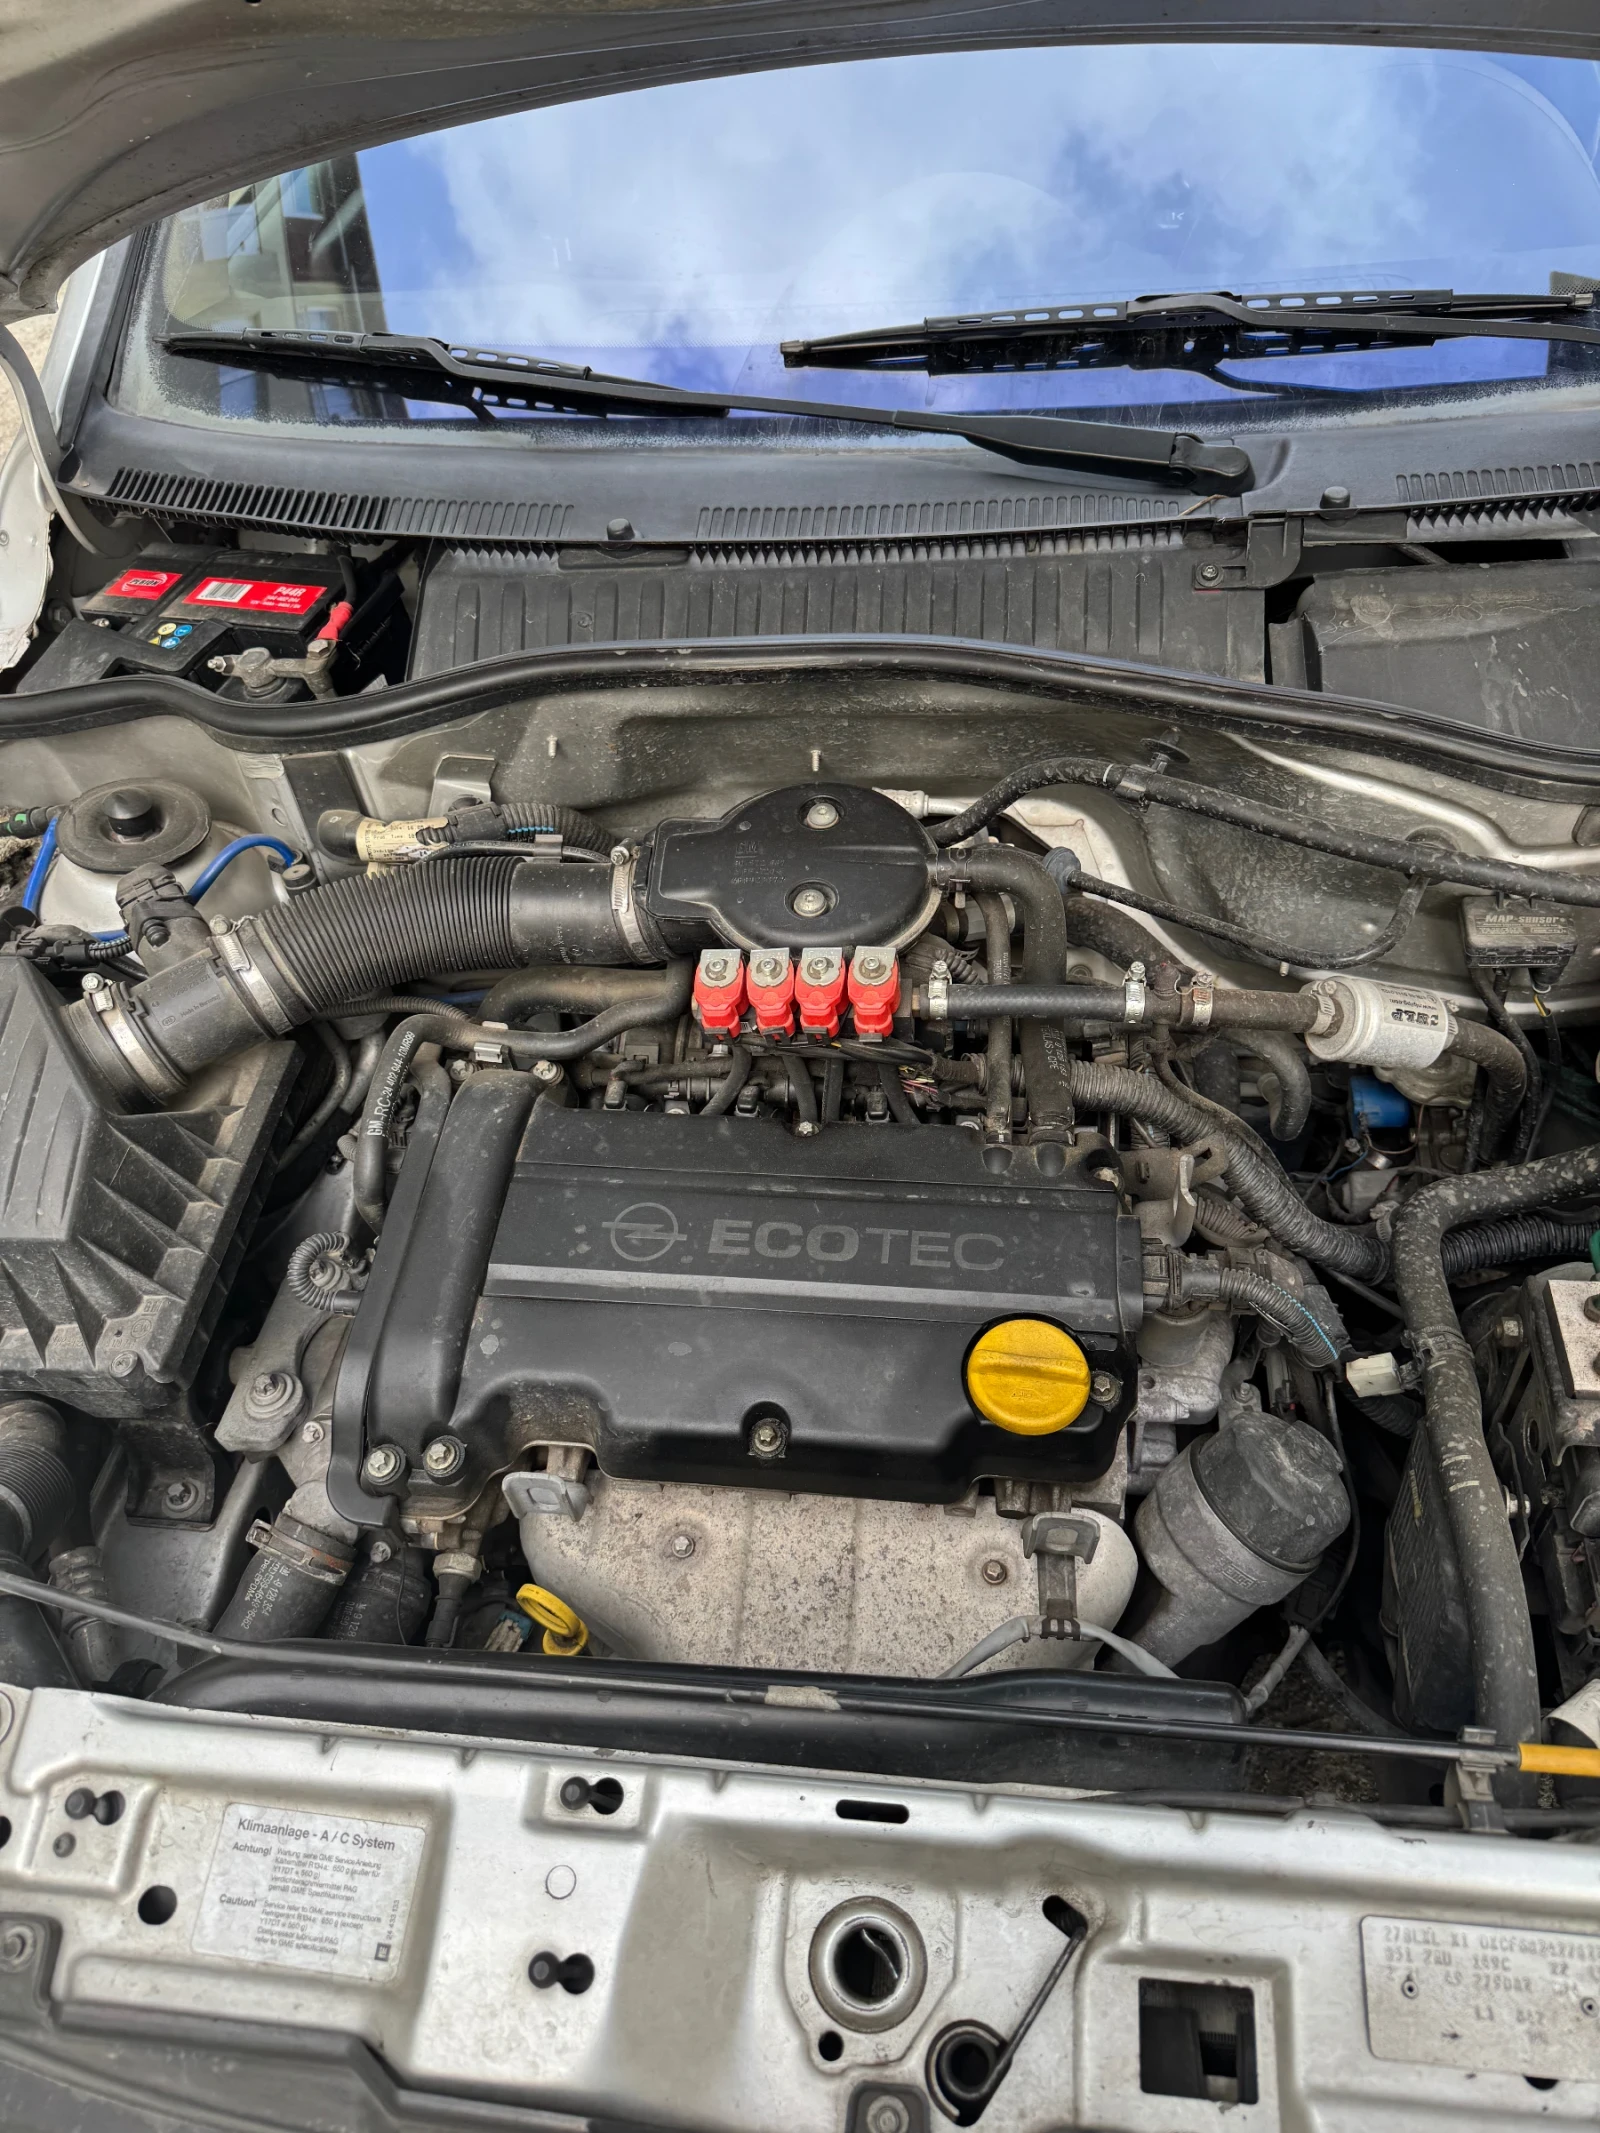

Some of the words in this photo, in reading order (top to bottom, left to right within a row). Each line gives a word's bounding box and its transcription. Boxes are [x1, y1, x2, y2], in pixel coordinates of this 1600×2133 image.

[707, 1218, 1005, 1272] ECOTEC
[238, 1817, 309, 1839] Klimaanlage
[320, 1830, 329, 1840] A
[340, 1832, 349, 1842] C
[352, 1834, 396, 1852] System
[232, 1842, 272, 1856] Achtung!
[219, 1893, 257, 1907] Caution!
